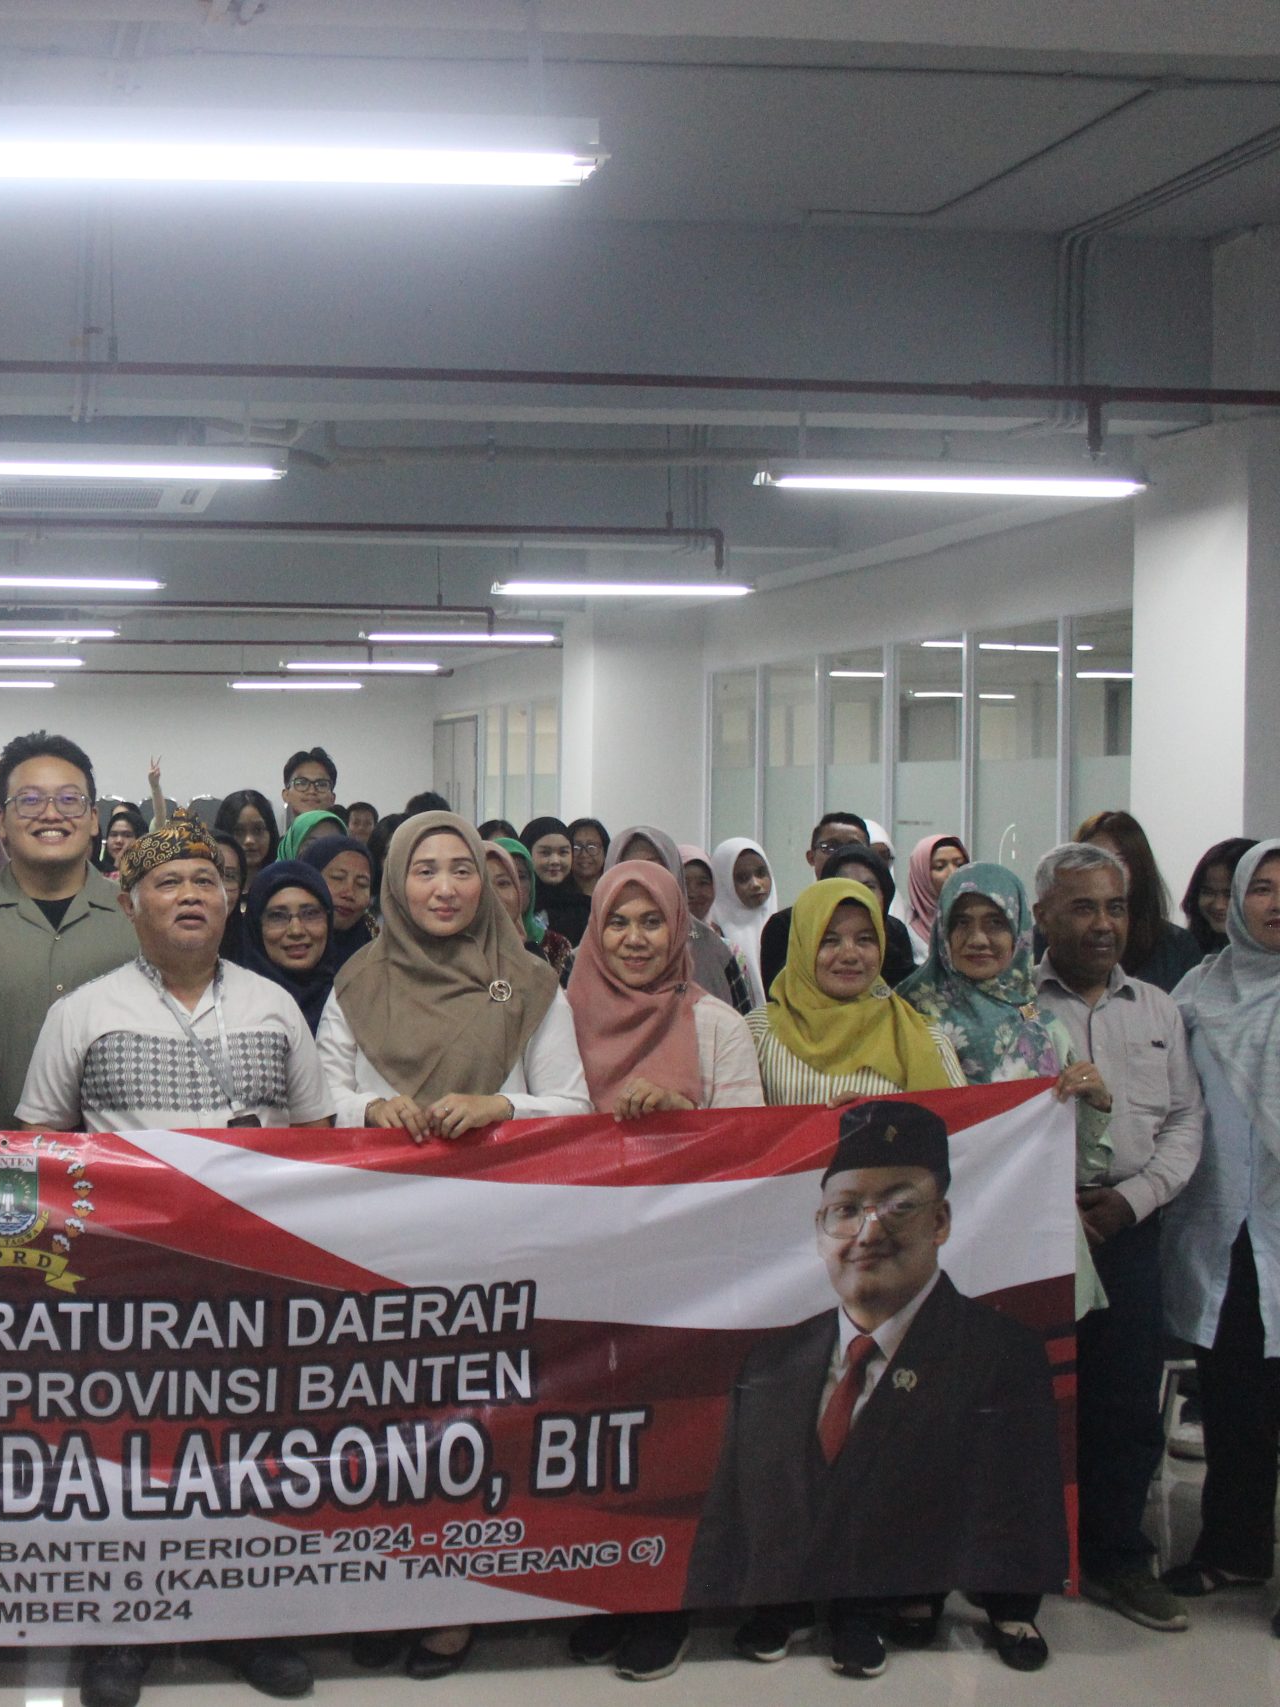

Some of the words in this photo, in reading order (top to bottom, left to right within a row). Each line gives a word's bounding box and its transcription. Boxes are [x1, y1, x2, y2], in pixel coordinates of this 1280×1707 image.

[287, 1285, 530, 1347] DAERAH
[297, 1349, 532, 1411] BANTEN
[130, 1421, 502, 1513] LAKSONO,
[536, 1411, 646, 1490] BIT
[123, 1571, 143, 1591] 6
[155, 1560, 386, 1593] (KABUPATEN
[399, 1540, 621, 1580] TANGERANG
[629, 1536, 665, 1566] C)
[159, 1533, 321, 1561] PERIODE
[333, 1526, 412, 1554] 2024
[443, 1520, 523, 1548] 2029
[112, 1600, 193, 1623] 2024
